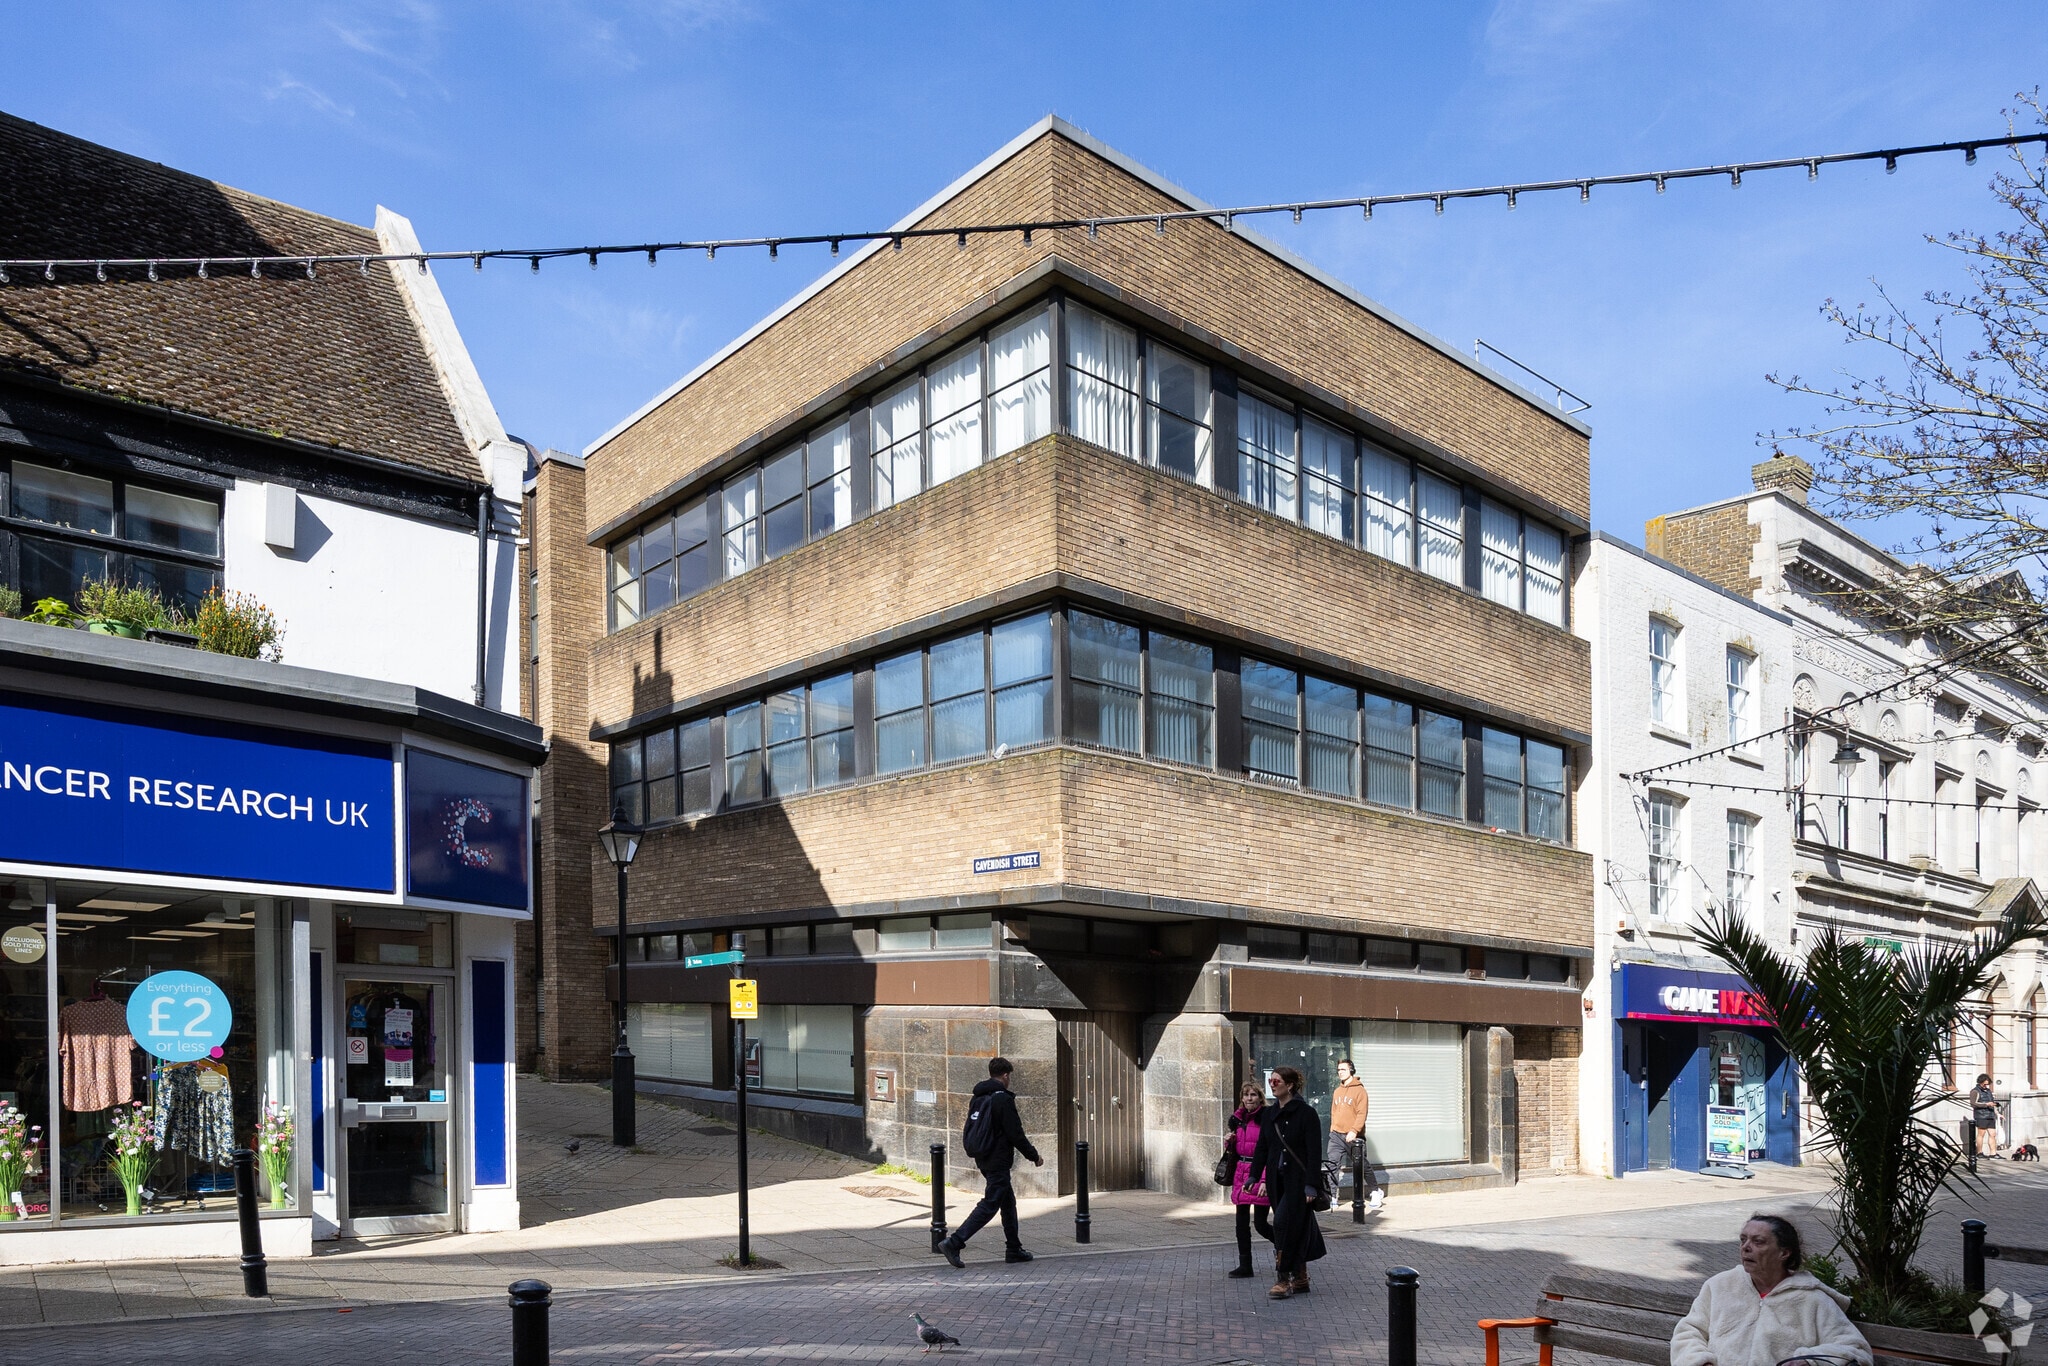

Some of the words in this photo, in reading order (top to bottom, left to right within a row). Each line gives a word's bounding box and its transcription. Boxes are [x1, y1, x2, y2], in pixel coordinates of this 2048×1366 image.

[0, 761, 111, 800] NCER
[129, 776, 313, 822] RESEARCH
[325, 799, 369, 828] UK
[975, 857, 1010, 872] CAVENDISH
[147, 981, 212, 996] Everything
[148, 996, 213, 1037] £2
[156, 1042, 173, 1052] or
[177, 1039, 206, 1053] less
